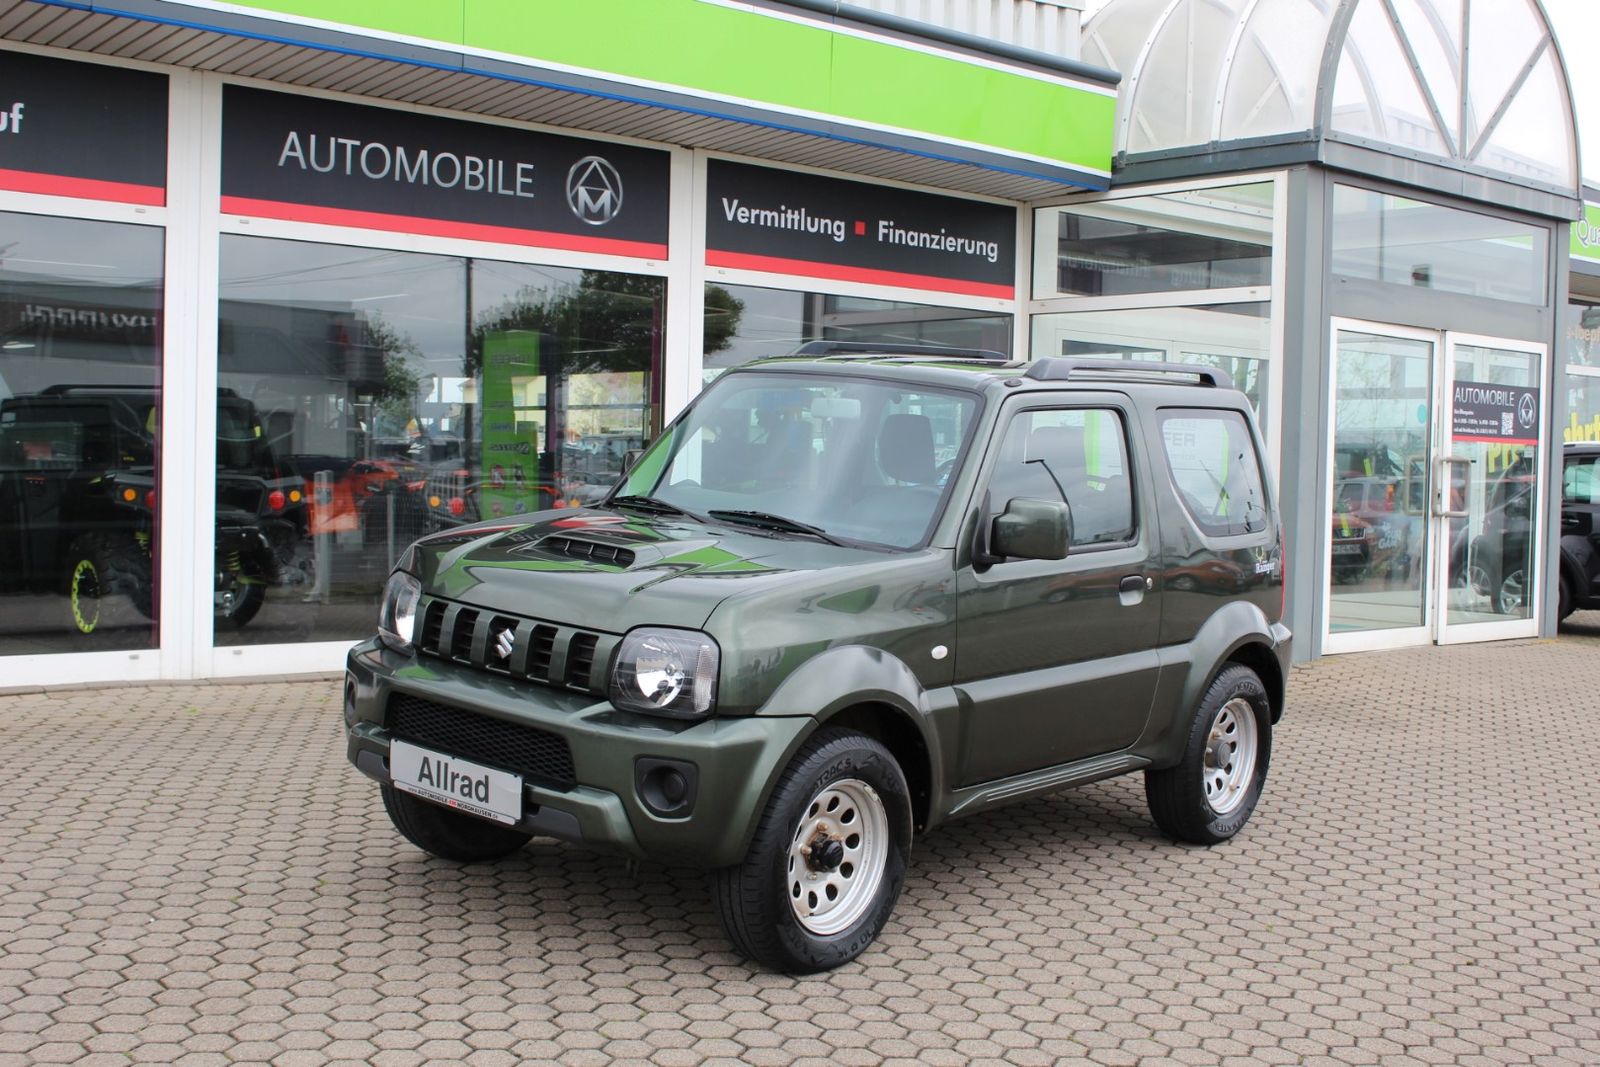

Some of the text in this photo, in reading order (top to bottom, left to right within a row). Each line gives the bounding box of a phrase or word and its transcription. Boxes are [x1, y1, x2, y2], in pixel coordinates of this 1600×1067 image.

[277, 130, 535, 199] AUTOMOBILE
[721, 197, 1000, 264] Vermittlung Finanzierung
[1454, 386, 1515, 407] AUTOMOBILE
[417, 755, 490, 804] Allrad
